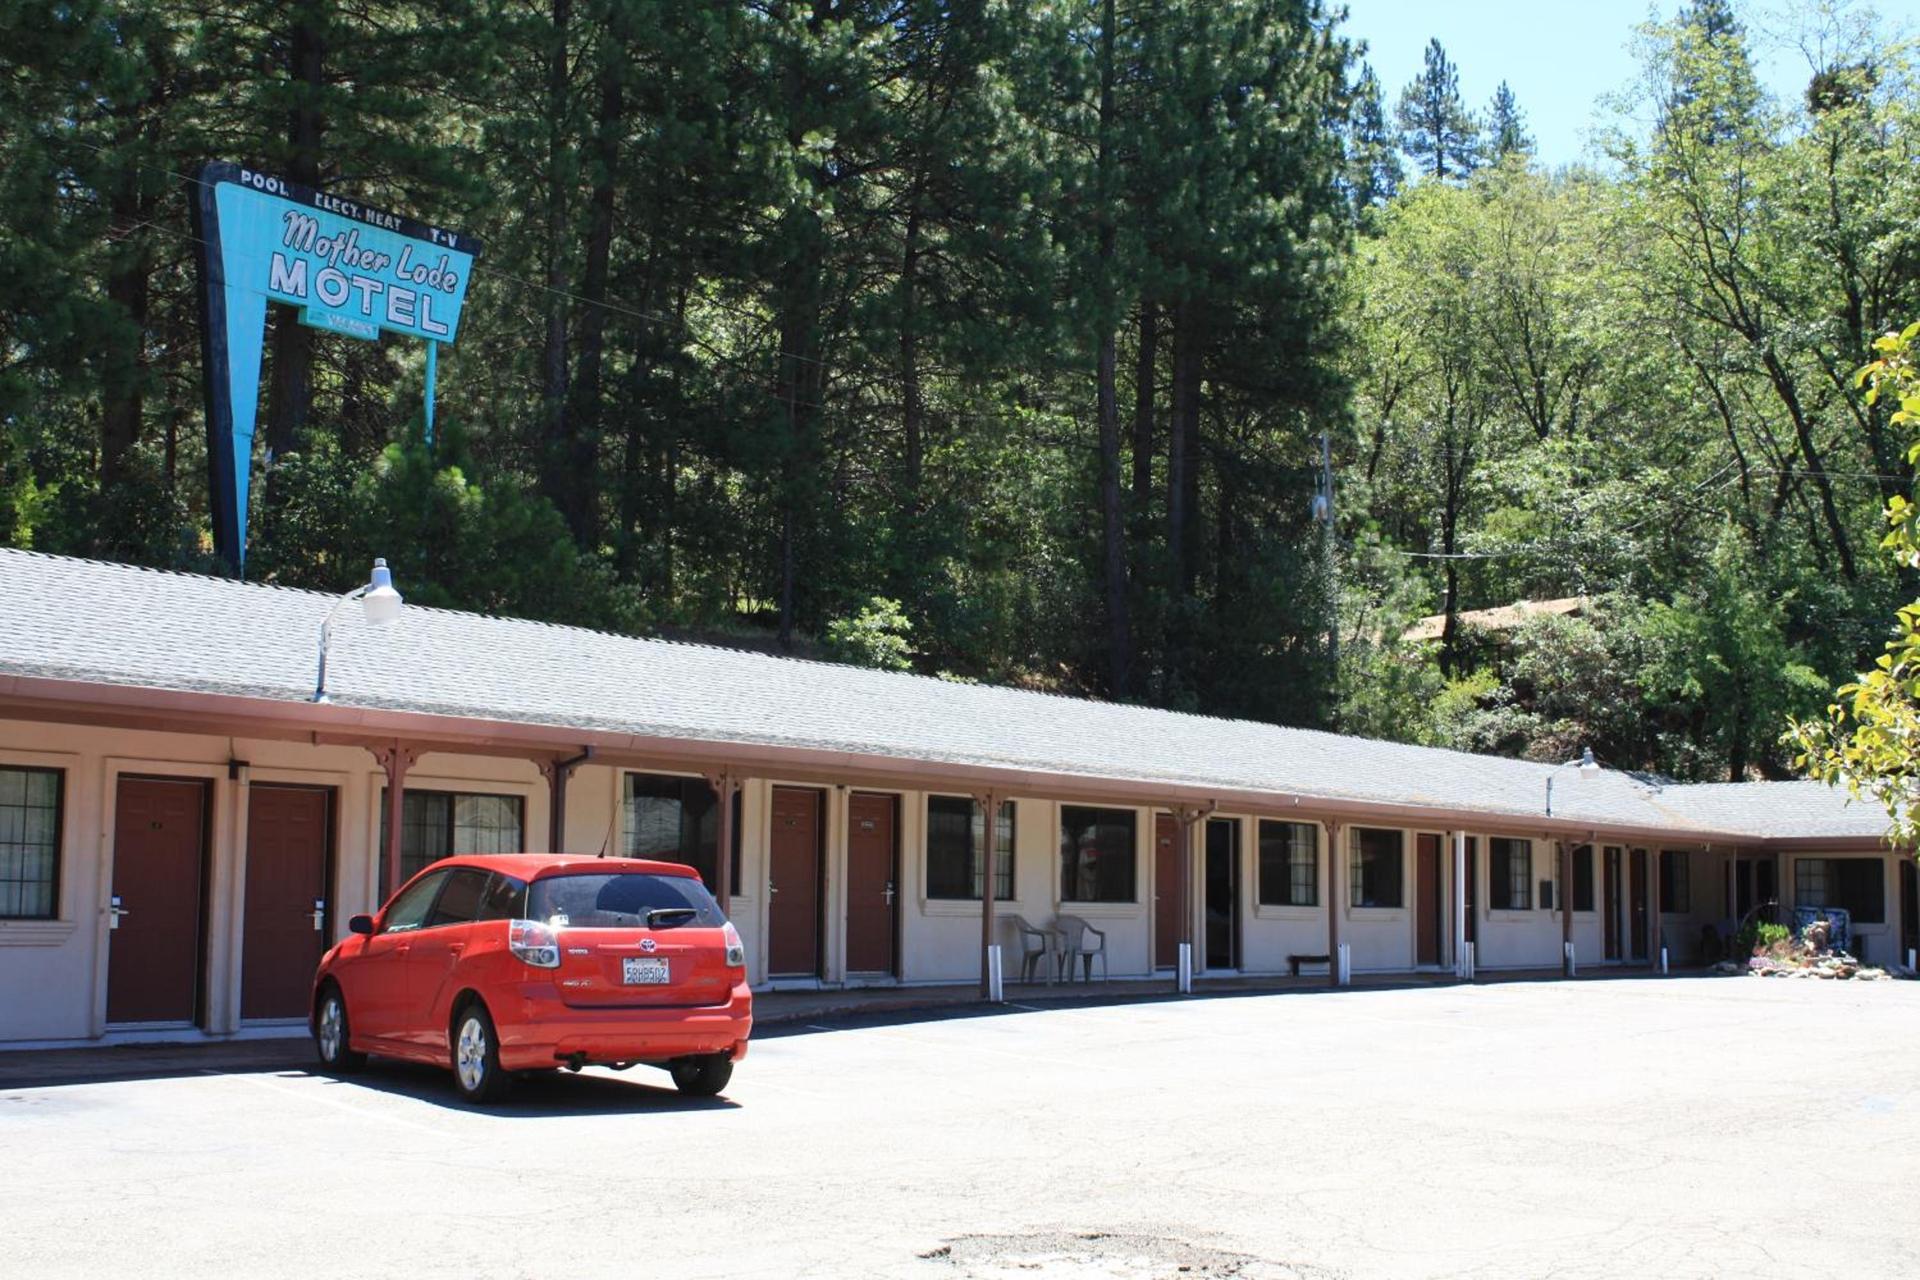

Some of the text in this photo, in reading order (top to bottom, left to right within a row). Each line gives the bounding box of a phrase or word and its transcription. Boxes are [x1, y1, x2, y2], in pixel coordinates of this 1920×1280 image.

[283, 209, 459, 293] Mother Lode
[366, 207, 402, 231] HEAT
[429, 227, 458, 248] T-V
[268, 251, 449, 336] MOTEL
